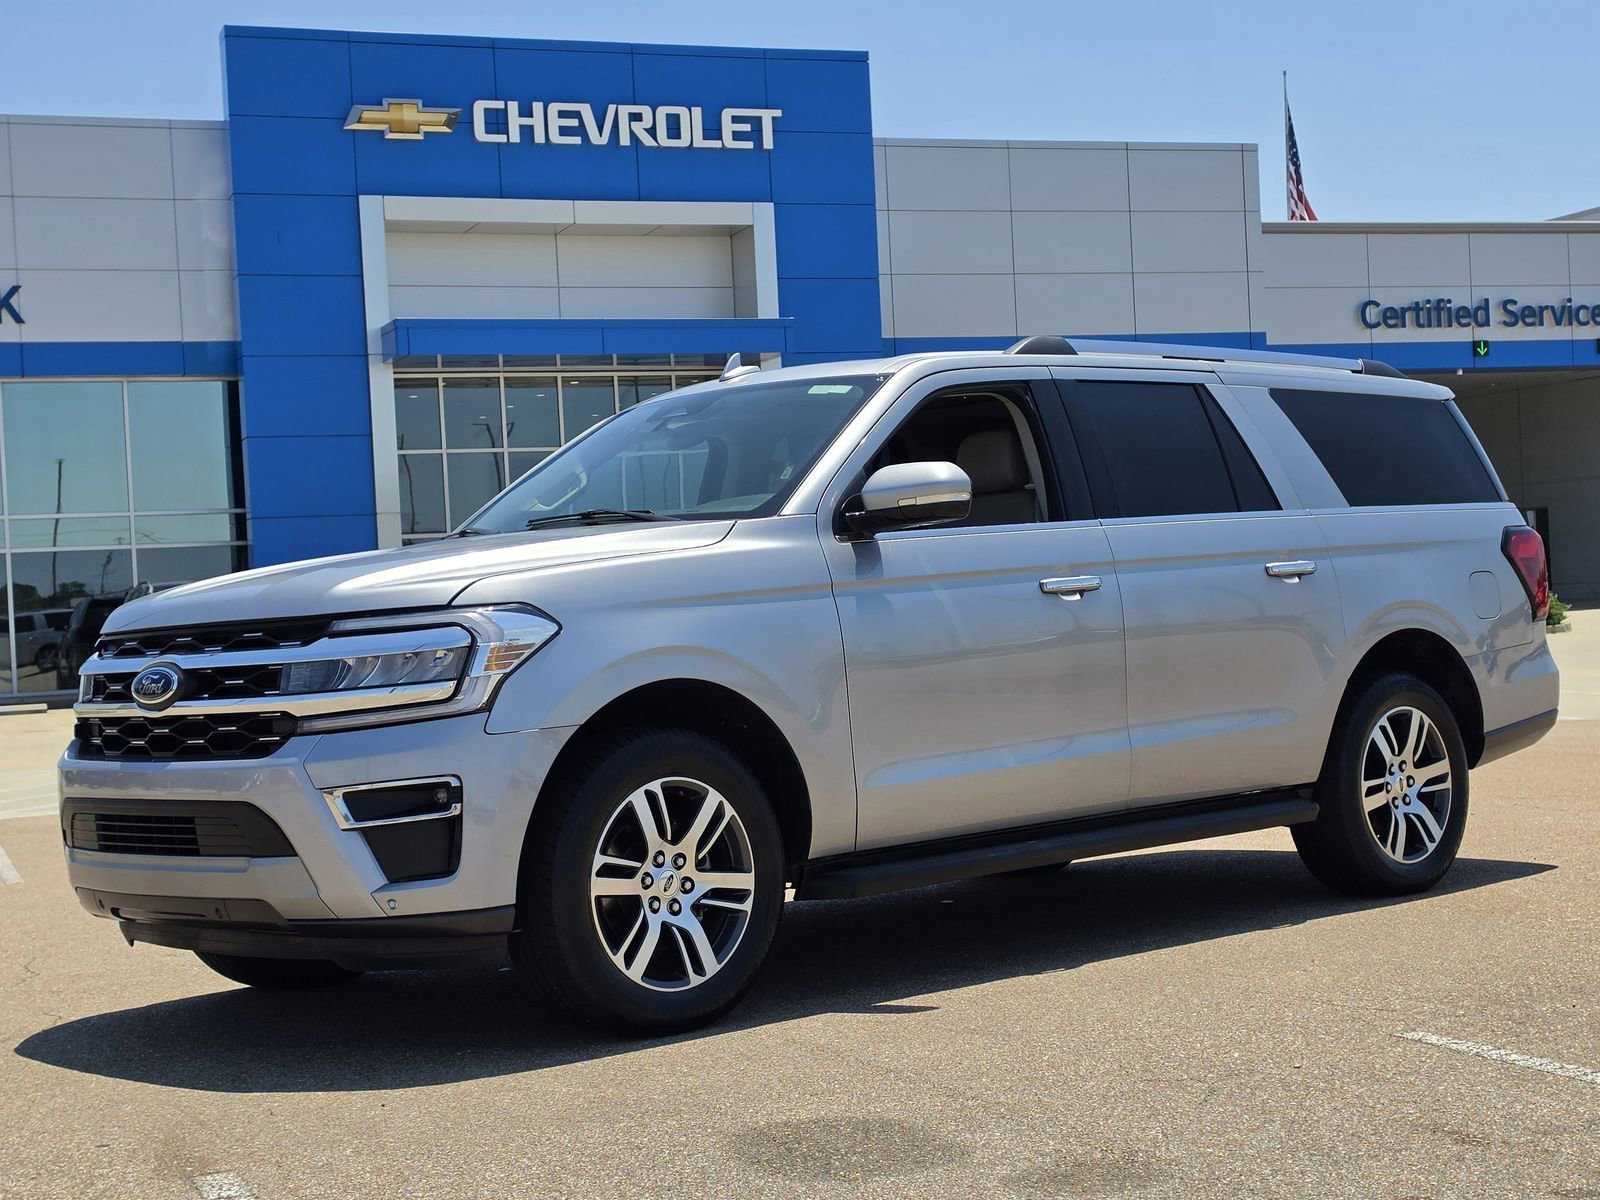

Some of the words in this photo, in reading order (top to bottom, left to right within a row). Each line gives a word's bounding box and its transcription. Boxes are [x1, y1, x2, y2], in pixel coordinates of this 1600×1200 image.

[472, 100, 782, 149] CHEVROLET
[1360, 298, 1491, 328] Certified
[1500, 298, 1600, 328] Service
[139, 674, 165, 696] Ford
